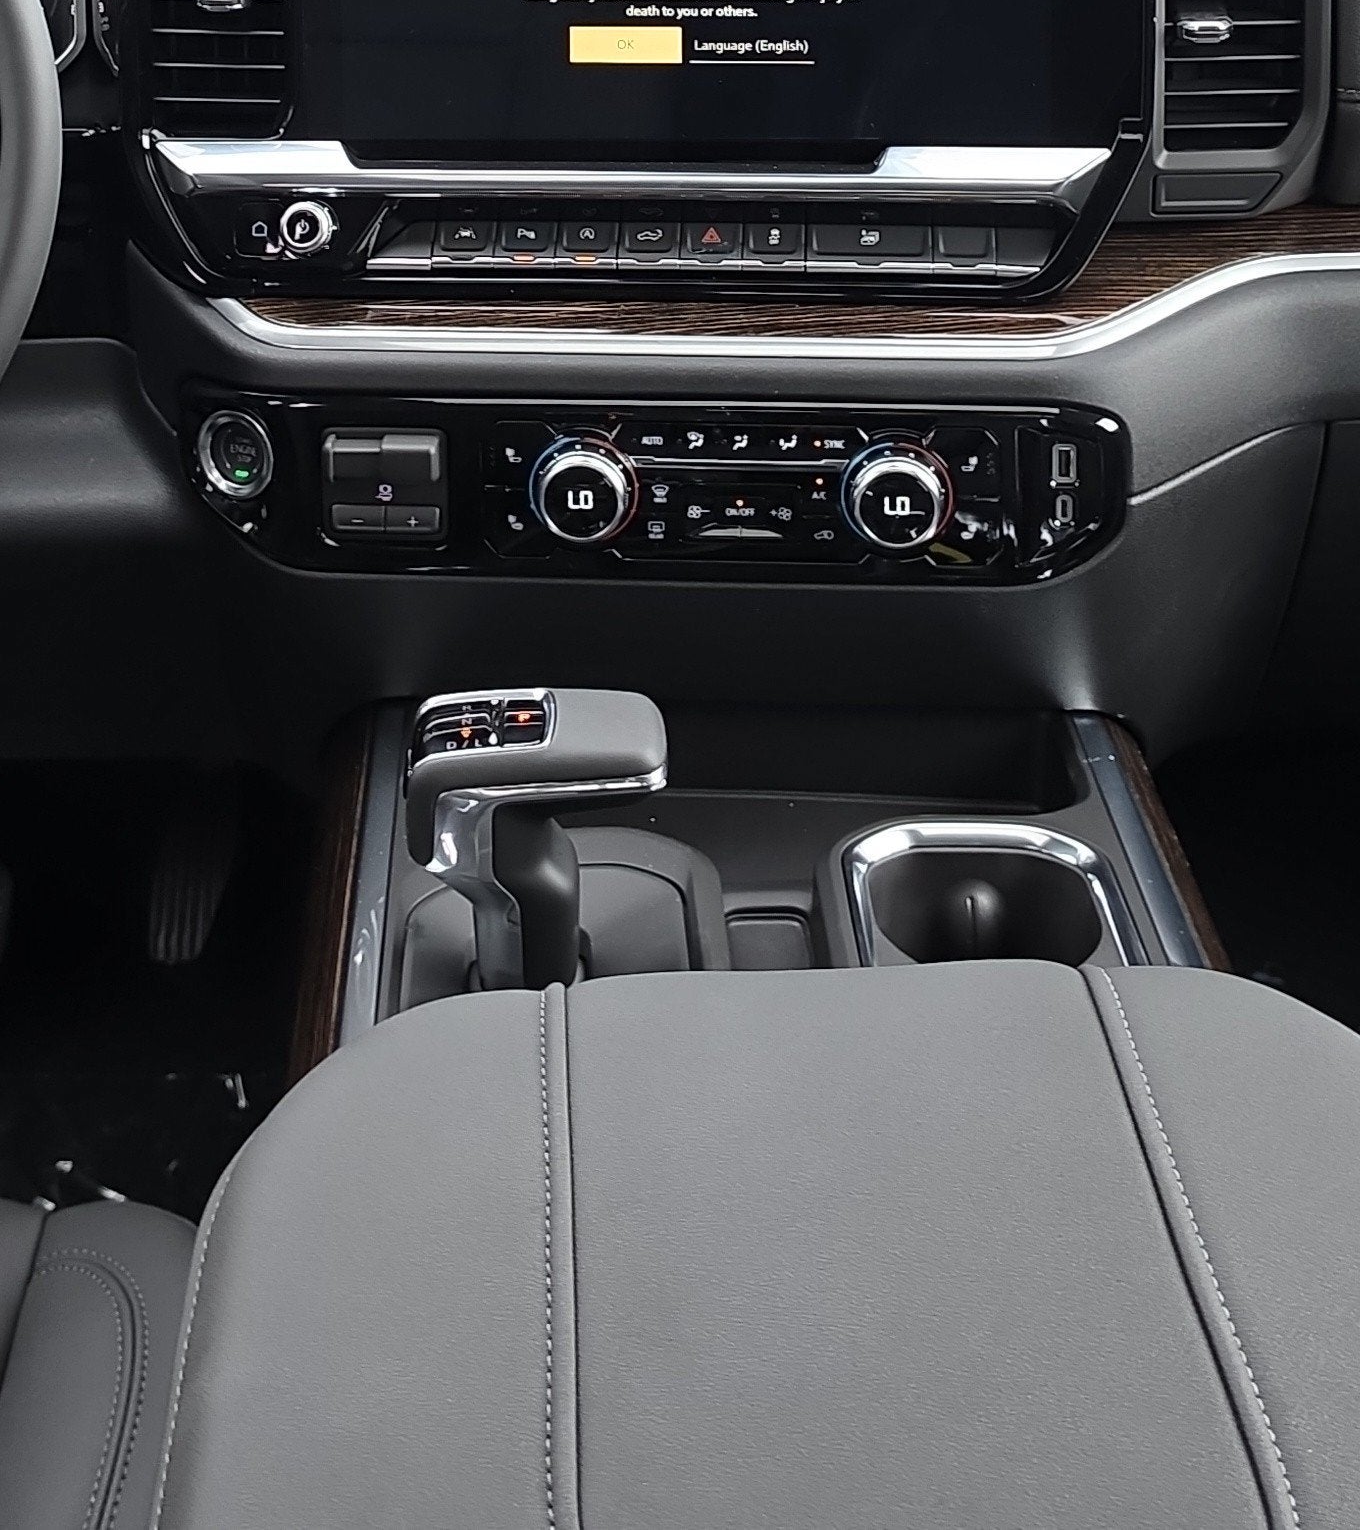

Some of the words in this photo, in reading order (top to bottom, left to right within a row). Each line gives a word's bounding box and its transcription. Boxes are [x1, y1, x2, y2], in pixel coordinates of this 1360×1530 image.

[626, 5, 660, 17] death
[661, 6, 675, 17] to
[676, 7, 698, 19] you
[700, 7, 714, 17] or
[715, 5, 758, 17] others.
[617, 39, 634, 50] OK
[693, 39, 753, 54] Language
[755, 39, 809, 54] (English)
[641, 436, 664, 446] AUTO
[823, 439, 845, 450] SYNC
[724, 507, 756, 518] ON/OFF
